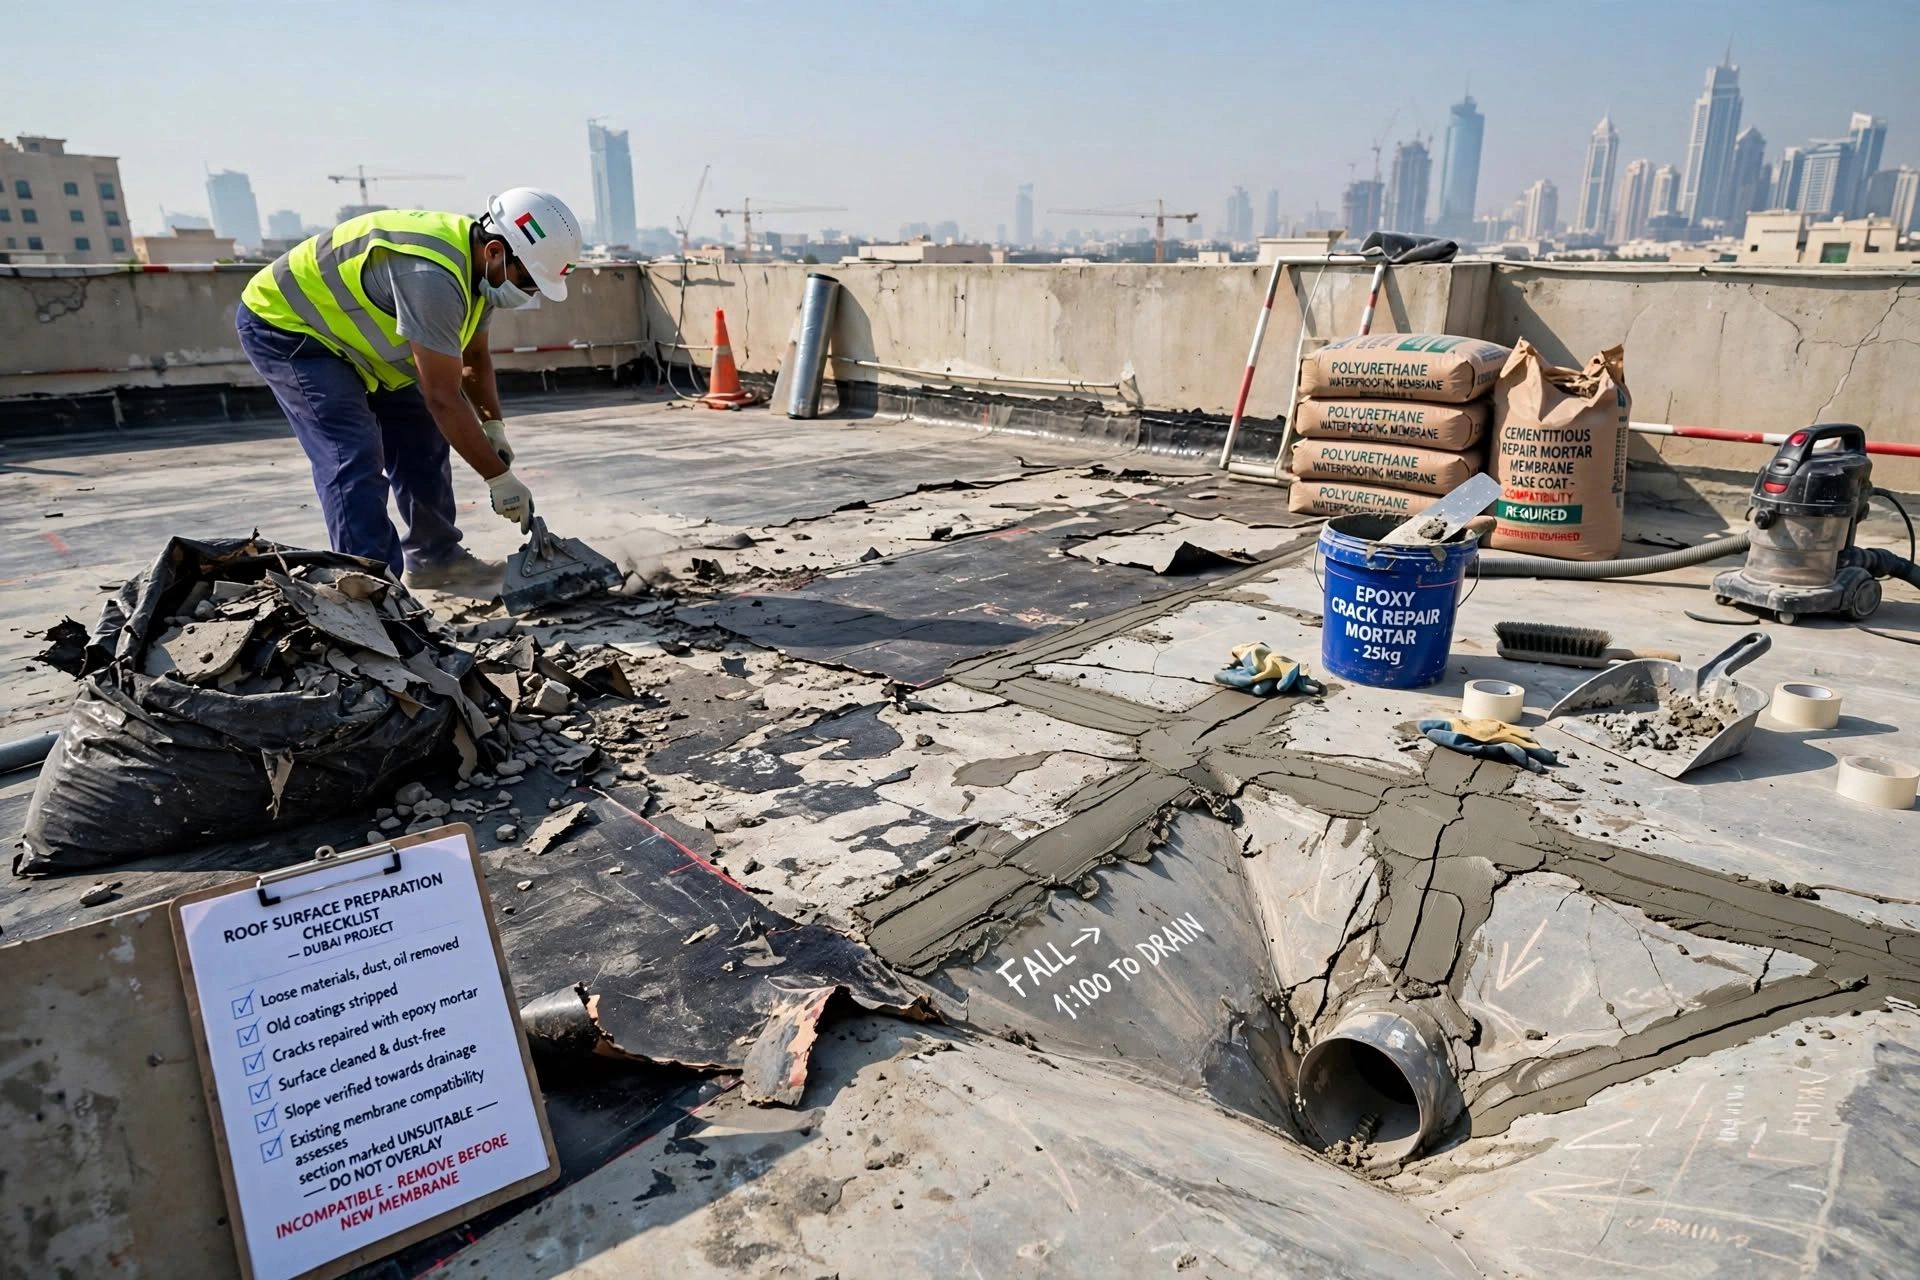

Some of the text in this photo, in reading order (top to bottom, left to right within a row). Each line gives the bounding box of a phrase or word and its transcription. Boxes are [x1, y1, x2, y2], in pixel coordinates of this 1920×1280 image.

[1331, 361, 1428, 377] POLYURETHANE
[1320, 420, 1388, 435] WATERPROOFNG
[1328, 406, 1425, 424] POLYURETHANE
[1504, 426, 1591, 443] CEMENTITIOUS
[1321, 447, 1419, 469] POLYURETHANE
[1502, 442, 1593, 459] REPAIR MORTAR
[1312, 461, 1437, 485] WATERPROOFING MEMBRANE
[1510, 460, 1574, 475] MEMBRANE
[1511, 475, 1535, 489] BASE
[1538, 477, 1569, 489] COAT
[1319, 486, 1410, 510] POLYURETHANE
[1331, 596, 1441, 626] CRACK REPAIR
[1355, 584, 1416, 608] EPOXY
[1345, 621, 1417, 645] MORTAR
[1362, 645, 1402, 666] 25kg
[223, 872, 444, 943] ROOF SURFACE PREPARATION
[302, 907, 381, 940] CHECKLIST
[303, 937, 342, 958] DUBAI
[344, 920, 395, 945] PROJECT
[260, 935, 460, 1008] Loose materials, dust, oil removed
[995, 941, 1077, 999] FALL
[1053, 972, 1112, 1020] 1:100
[1135, 911, 1205, 968] DRAIN
[266, 982, 399, 1035] Old coatings stripped
[272, 986, 479, 1063] Cracks repaired with epoxy mortar
[278, 1025, 447, 1092] Surface cleaned & dust-free
[284, 1043, 478, 1120] Slope verified towards drainage
[289, 1069, 485, 1149] Existing membrane compatibility
[295, 1138, 349, 1168] assesses
[298, 1159, 346, 1186] section
[349, 1135, 396, 1166] marked
[397, 1105, 475, 1146] UNSUITABLE
[329, 1173, 352, 1192] DO
[354, 1160, 384, 1183] NOT
[385, 1135, 445, 1169] OVERLAY
[275, 1183, 385, 1240] INCOMPATIBLE
[396, 1154, 456, 1190] REMOVE
[457, 1133, 510, 1165] BEFORE
[339, 1170, 461, 1231] NEW MEMBRANE
